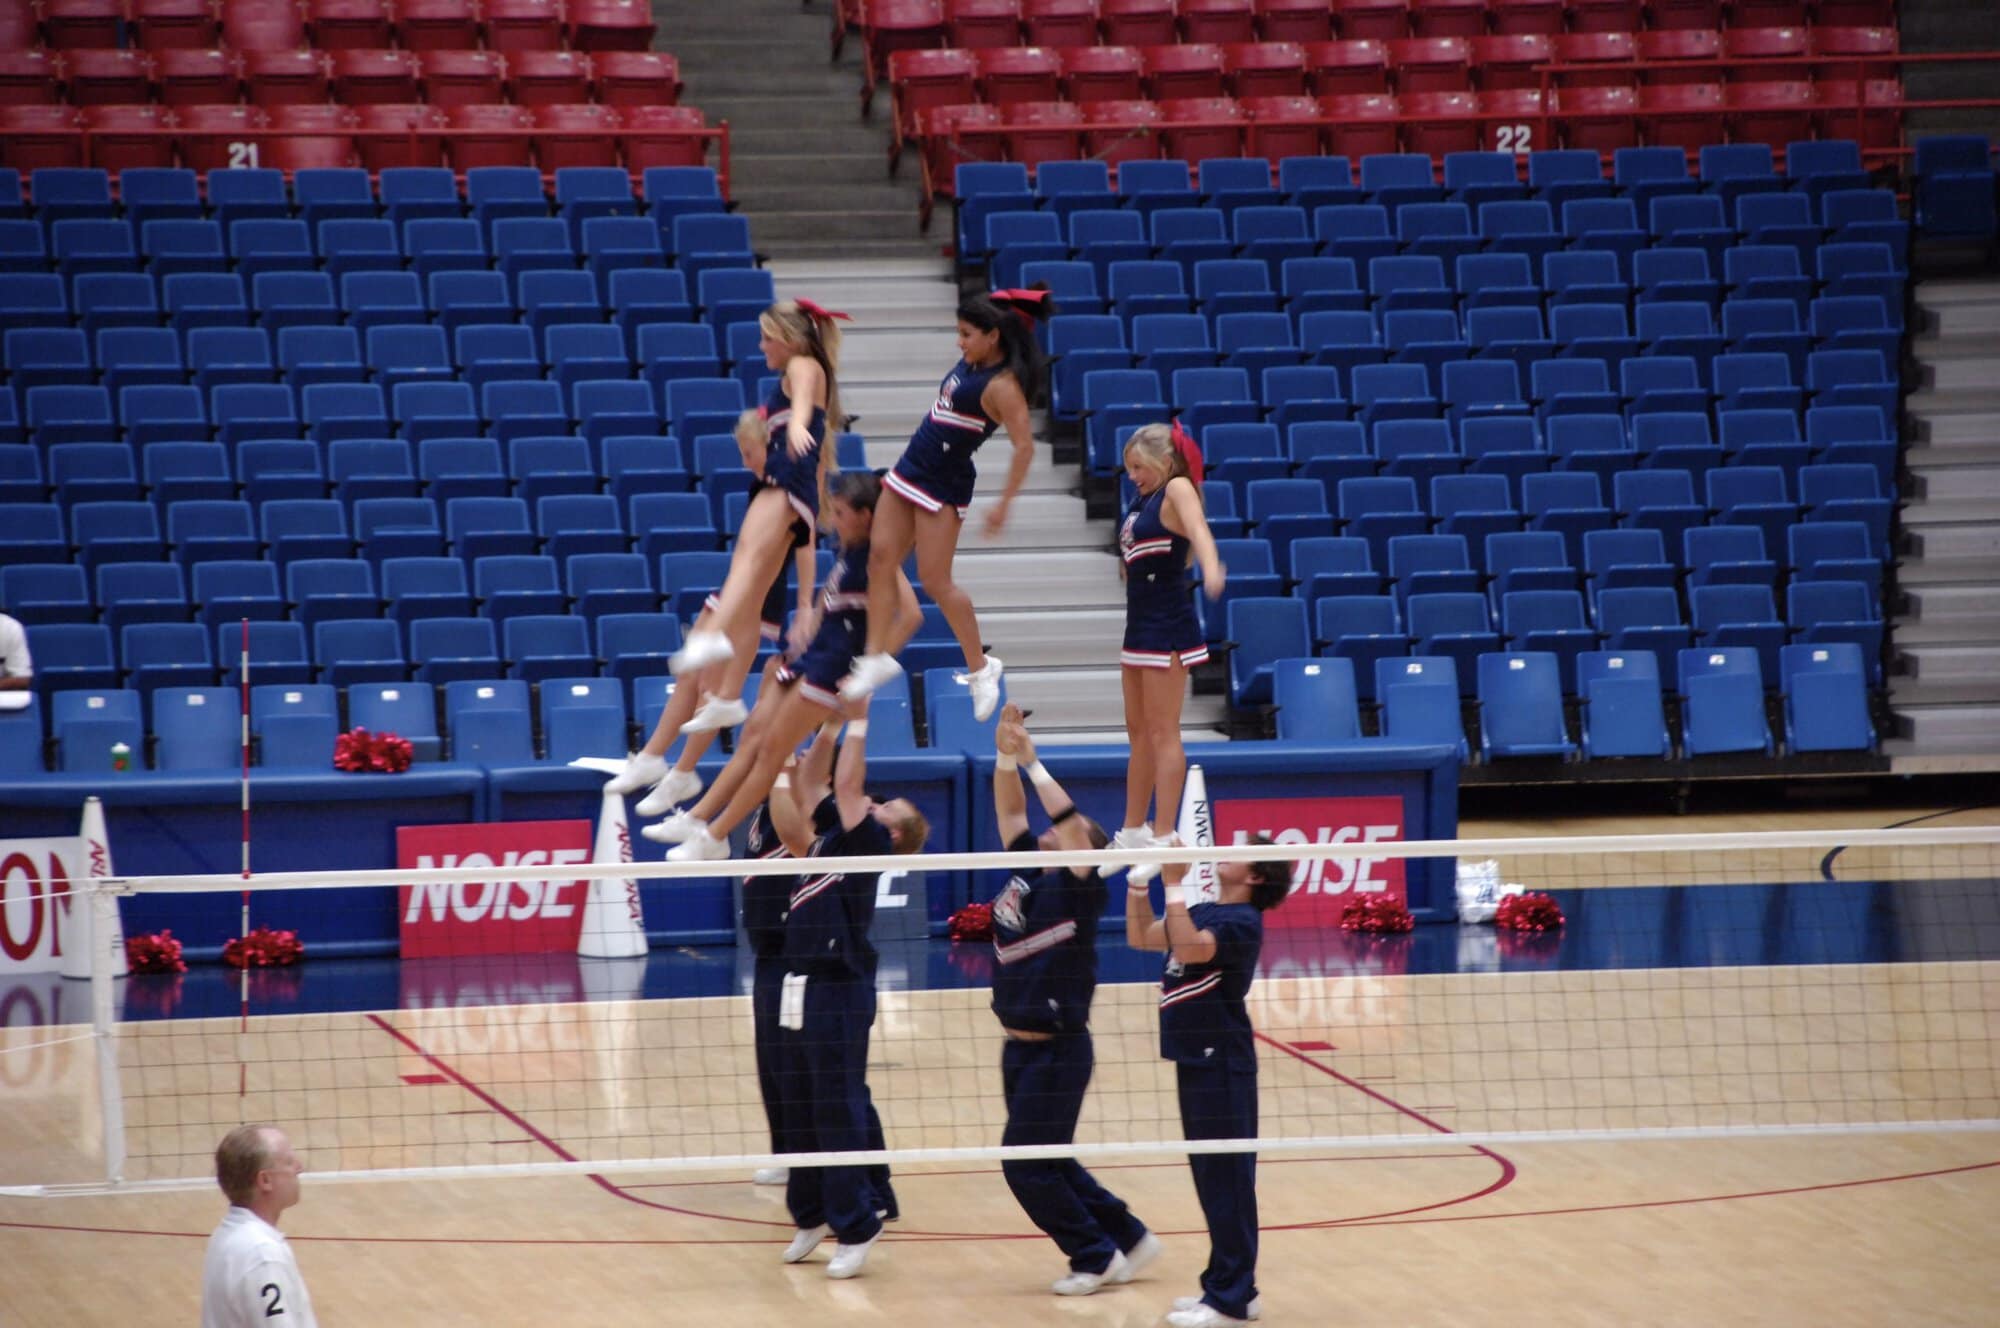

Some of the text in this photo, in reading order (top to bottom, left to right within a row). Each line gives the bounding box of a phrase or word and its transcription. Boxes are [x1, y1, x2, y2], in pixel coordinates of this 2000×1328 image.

[228, 142, 258, 169] 21
[1496, 125, 1531, 153] 22
[1232, 825, 1399, 895] OISE
[404, 849, 587, 924] NOISE
[261, 1283, 284, 1317] 2
